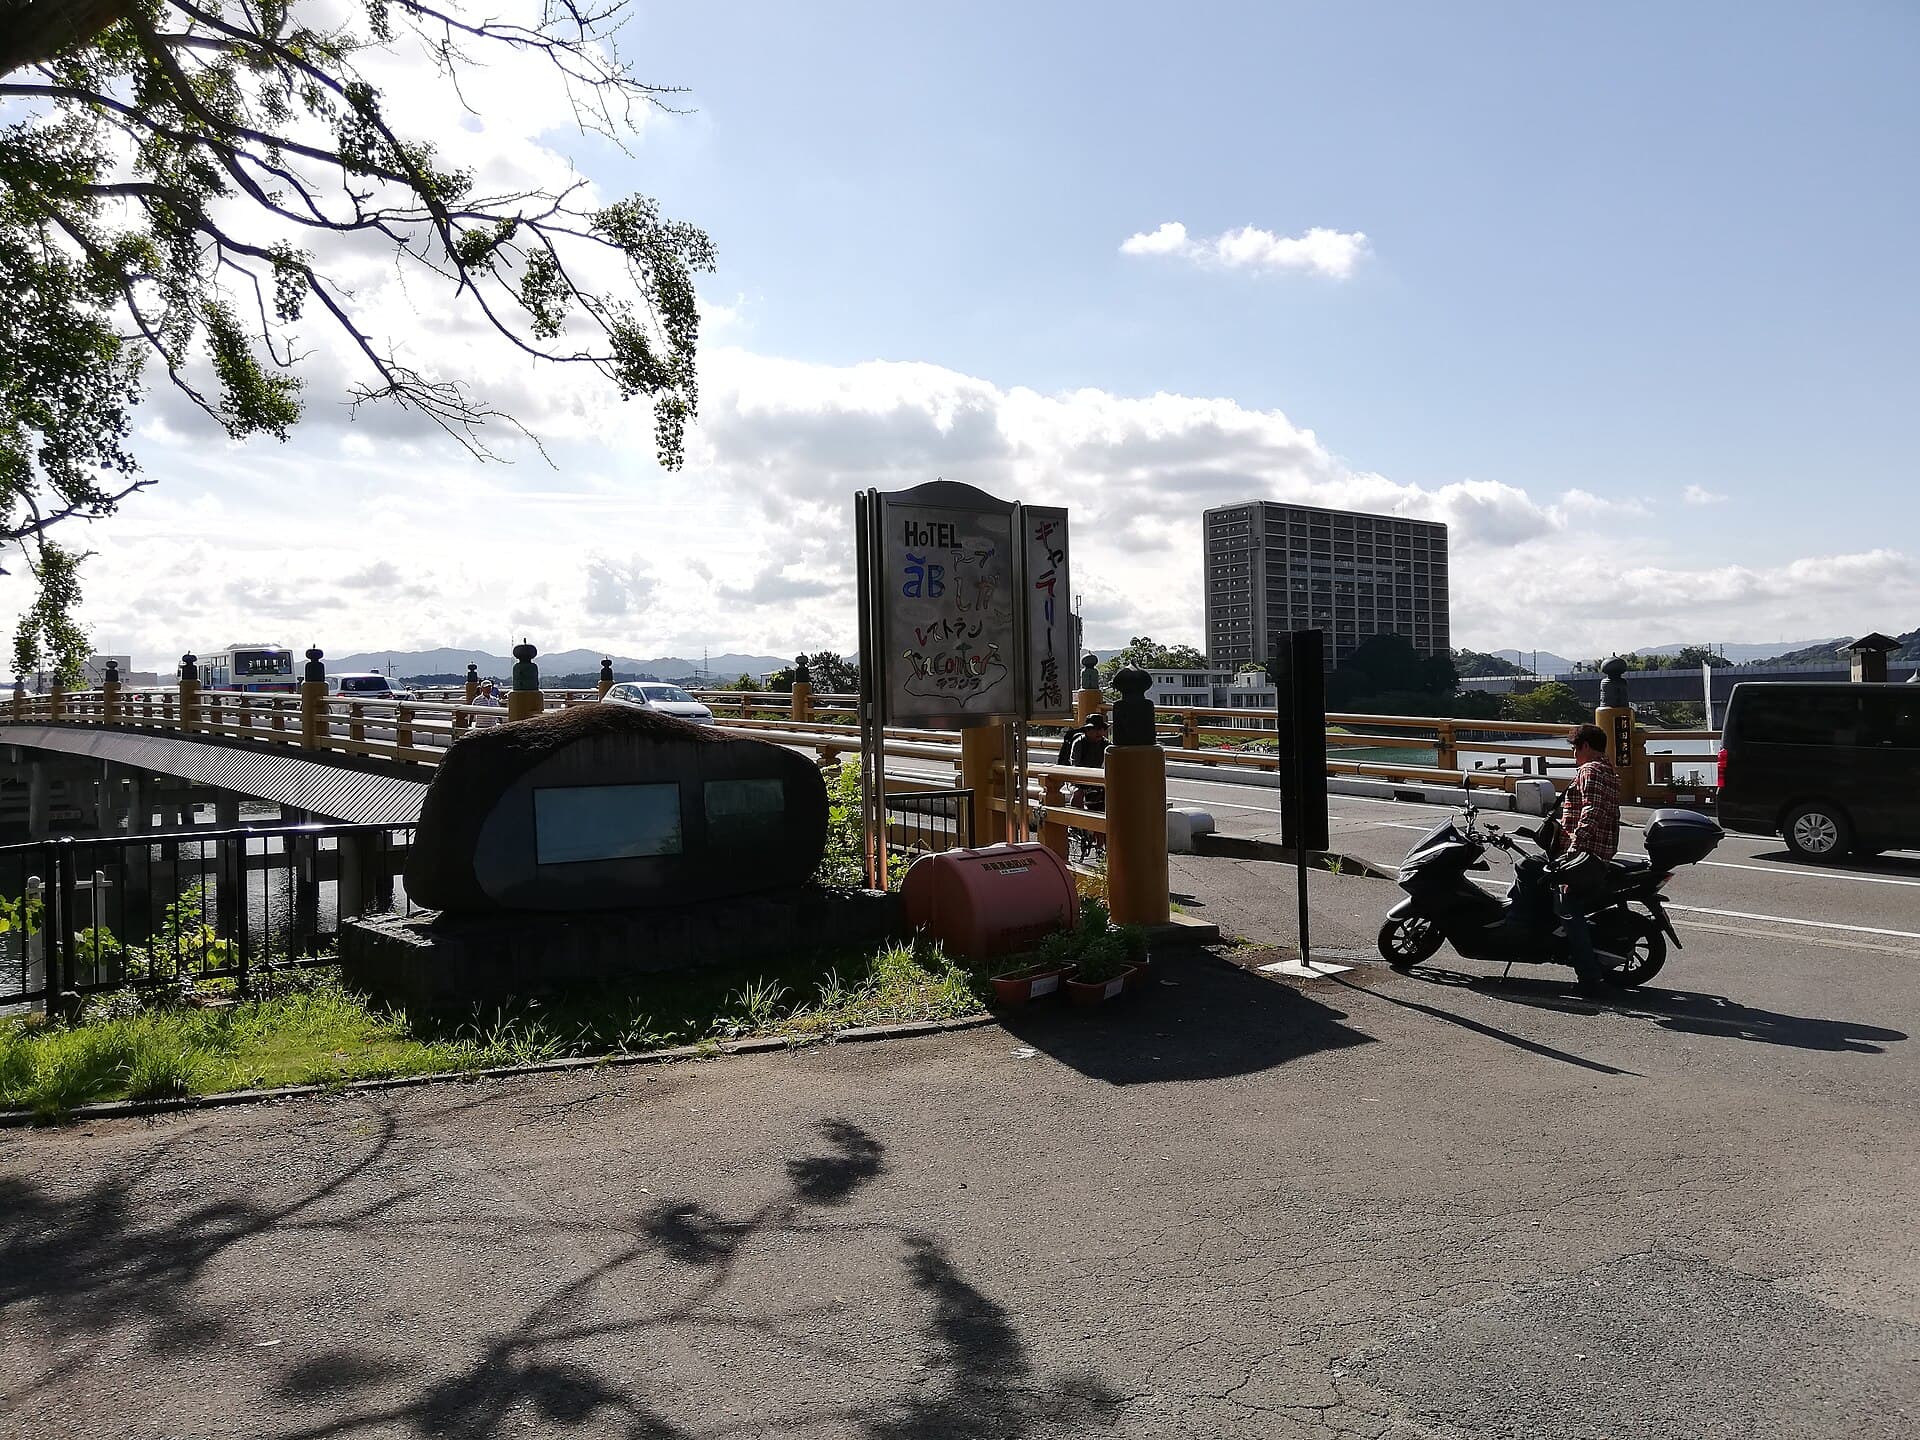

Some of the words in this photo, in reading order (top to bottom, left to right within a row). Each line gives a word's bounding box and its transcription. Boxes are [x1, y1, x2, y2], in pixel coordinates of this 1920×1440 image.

[915, 617, 983, 648] レストラン
